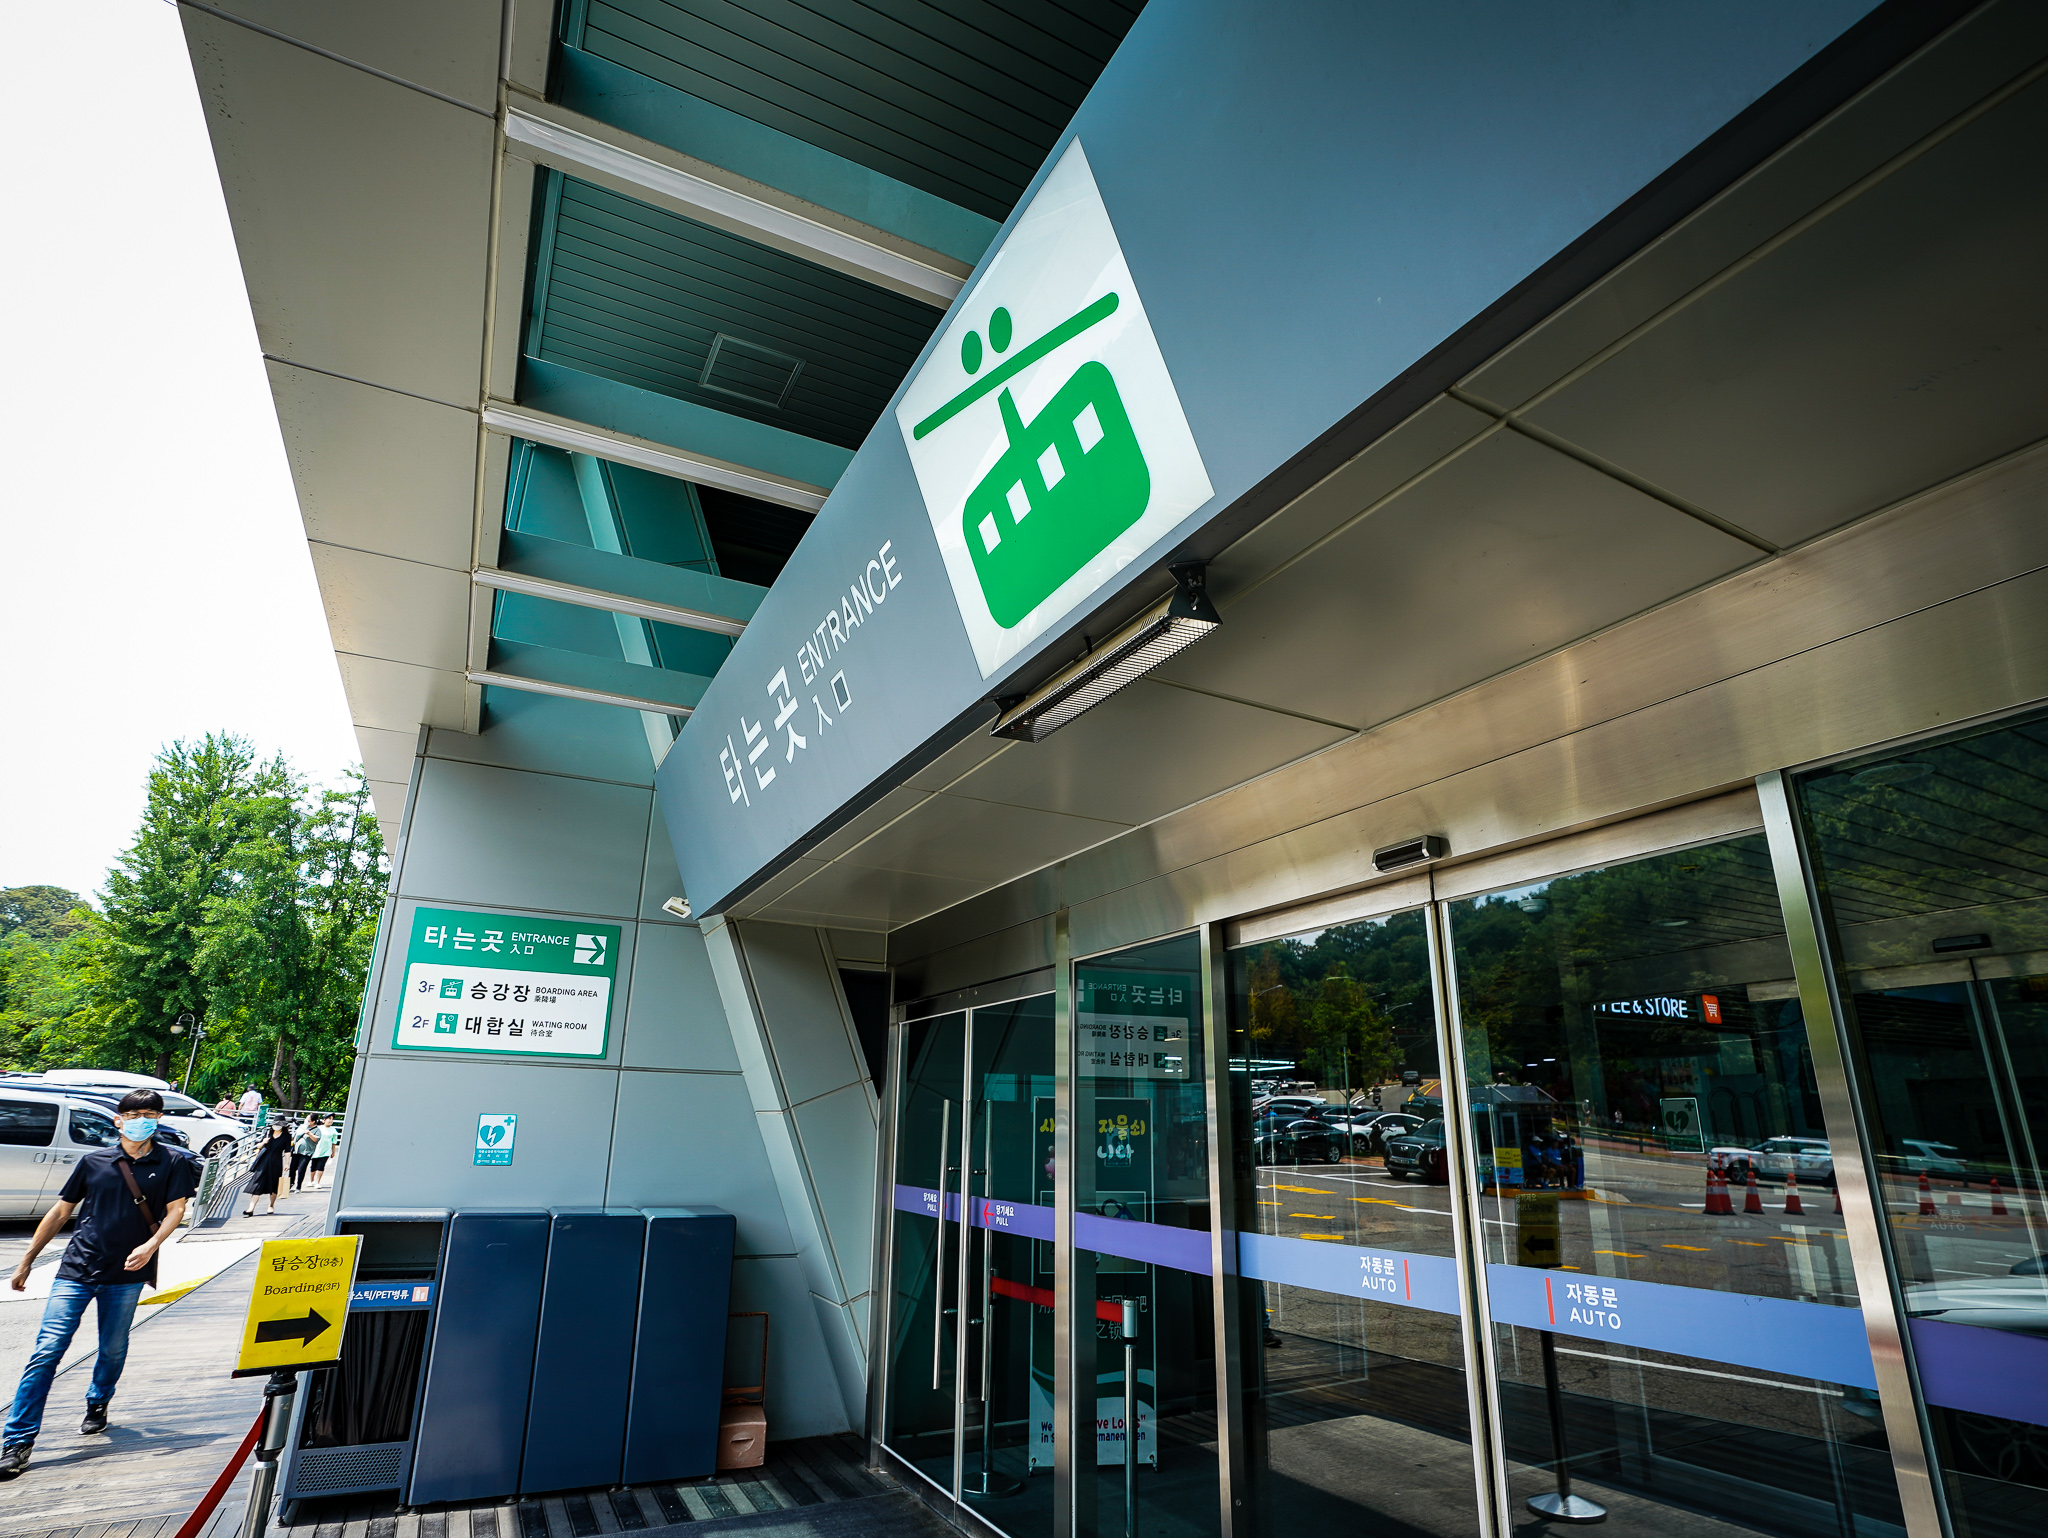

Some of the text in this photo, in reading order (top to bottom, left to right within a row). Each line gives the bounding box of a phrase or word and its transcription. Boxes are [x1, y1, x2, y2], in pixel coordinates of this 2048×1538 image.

[797, 539, 902, 687] ENTRANCE
[511, 932, 570, 946] ENTRANCE
[418, 980, 435, 993] 3F
[470, 981, 531, 1002] 승강장
[535, 986, 598, 998] BOARDING AREA
[1644, 996, 1689, 1019] STORE
[412, 1015, 430, 1029] 2F
[464, 1016, 525, 1037] 대합실
[532, 1020, 588, 1031] WATING ROOM
[926, 1203, 938, 1212] PULL
[996, 1216, 1009, 1227] PULL
[271, 1254, 344, 1272] 탑승장(3층)
[1360, 1255, 1395, 1276] 자동문
[263, 1281, 340, 1296] Boarding(3F)
[1361, 1275, 1397, 1293] AUTO
[1566, 1283, 1618, 1309] 자동문
[1569, 1307, 1622, 1330] AUTO
[1041, 1421, 1053, 1431] We
